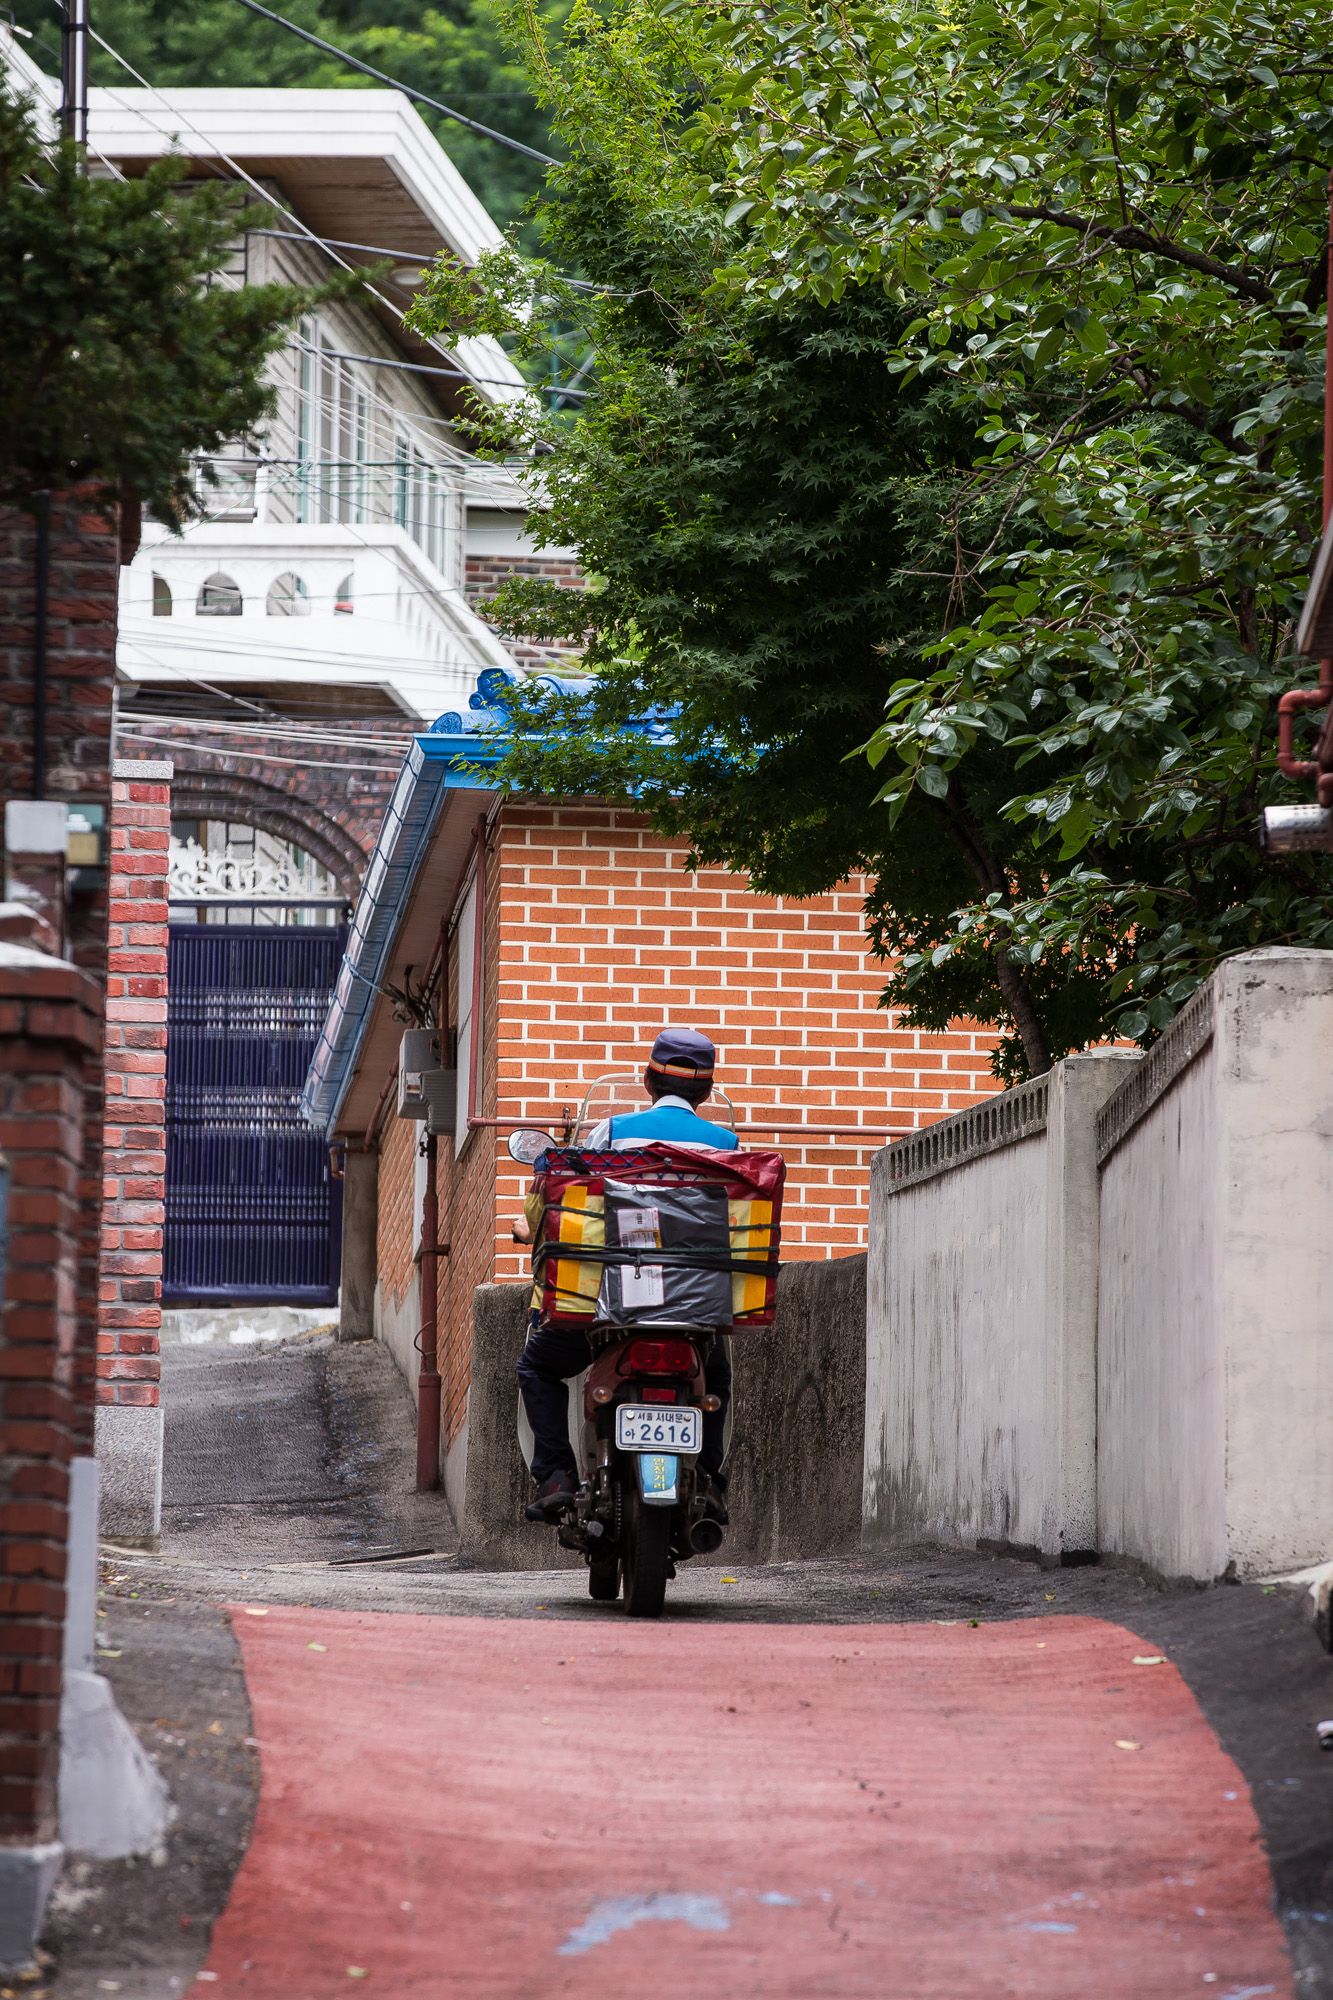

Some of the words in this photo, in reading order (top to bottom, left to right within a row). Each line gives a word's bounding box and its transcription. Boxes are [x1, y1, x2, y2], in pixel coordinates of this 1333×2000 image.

[637, 1412, 653, 1421] 서울
[656, 1412, 683, 1423] 서대문
[625, 1428, 636, 1440] 아
[640, 1424, 691, 1443] 2616
[652, 1457, 666, 1490] 안전거리
